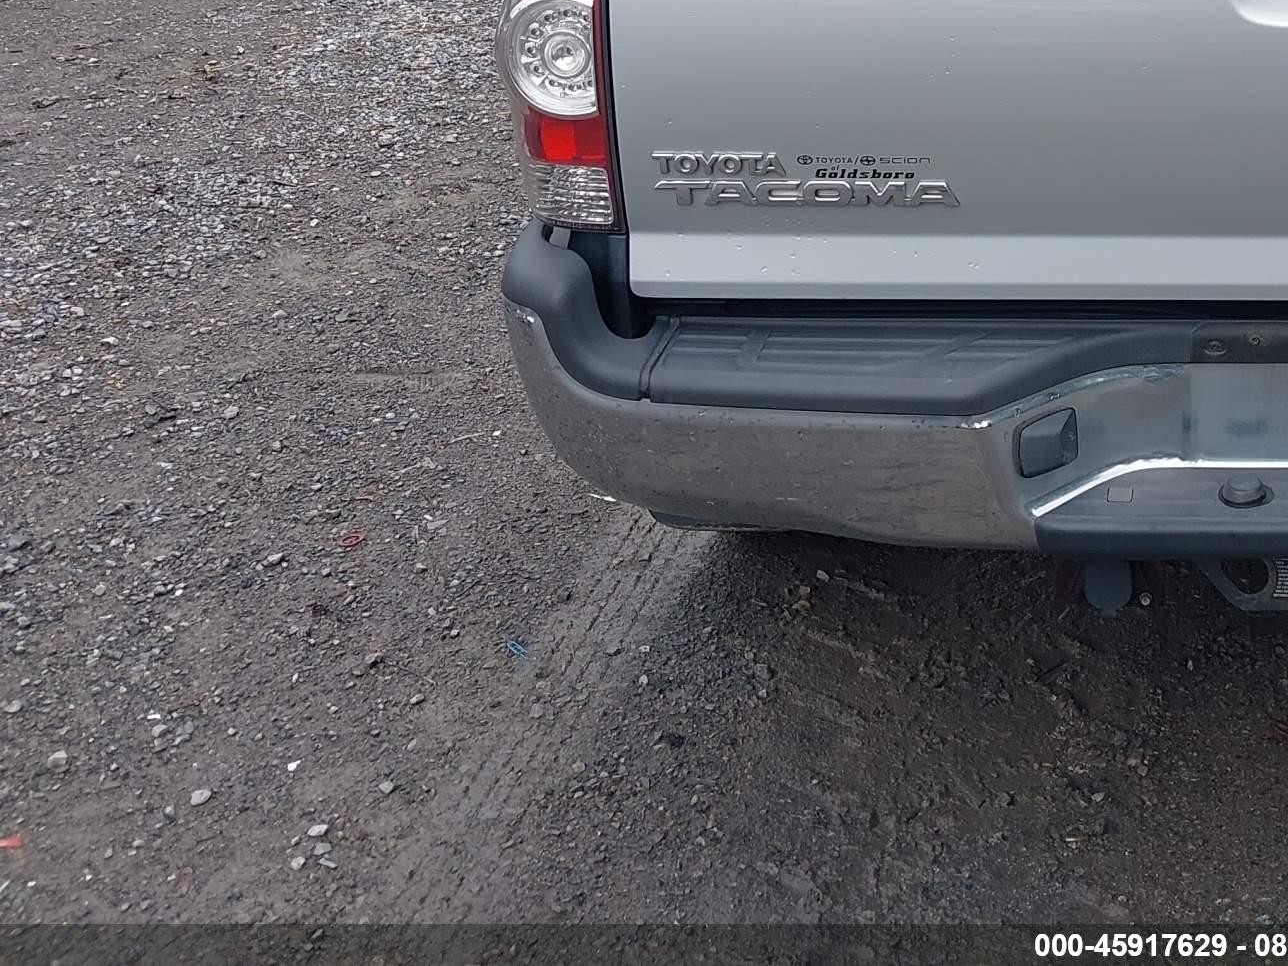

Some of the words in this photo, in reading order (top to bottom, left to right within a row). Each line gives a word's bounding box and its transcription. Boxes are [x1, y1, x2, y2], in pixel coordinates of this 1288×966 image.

[651, 151, 786, 176] TOYOTA
[815, 168, 915, 179] Goldsboro
[653, 180, 960, 207] TACOMA
